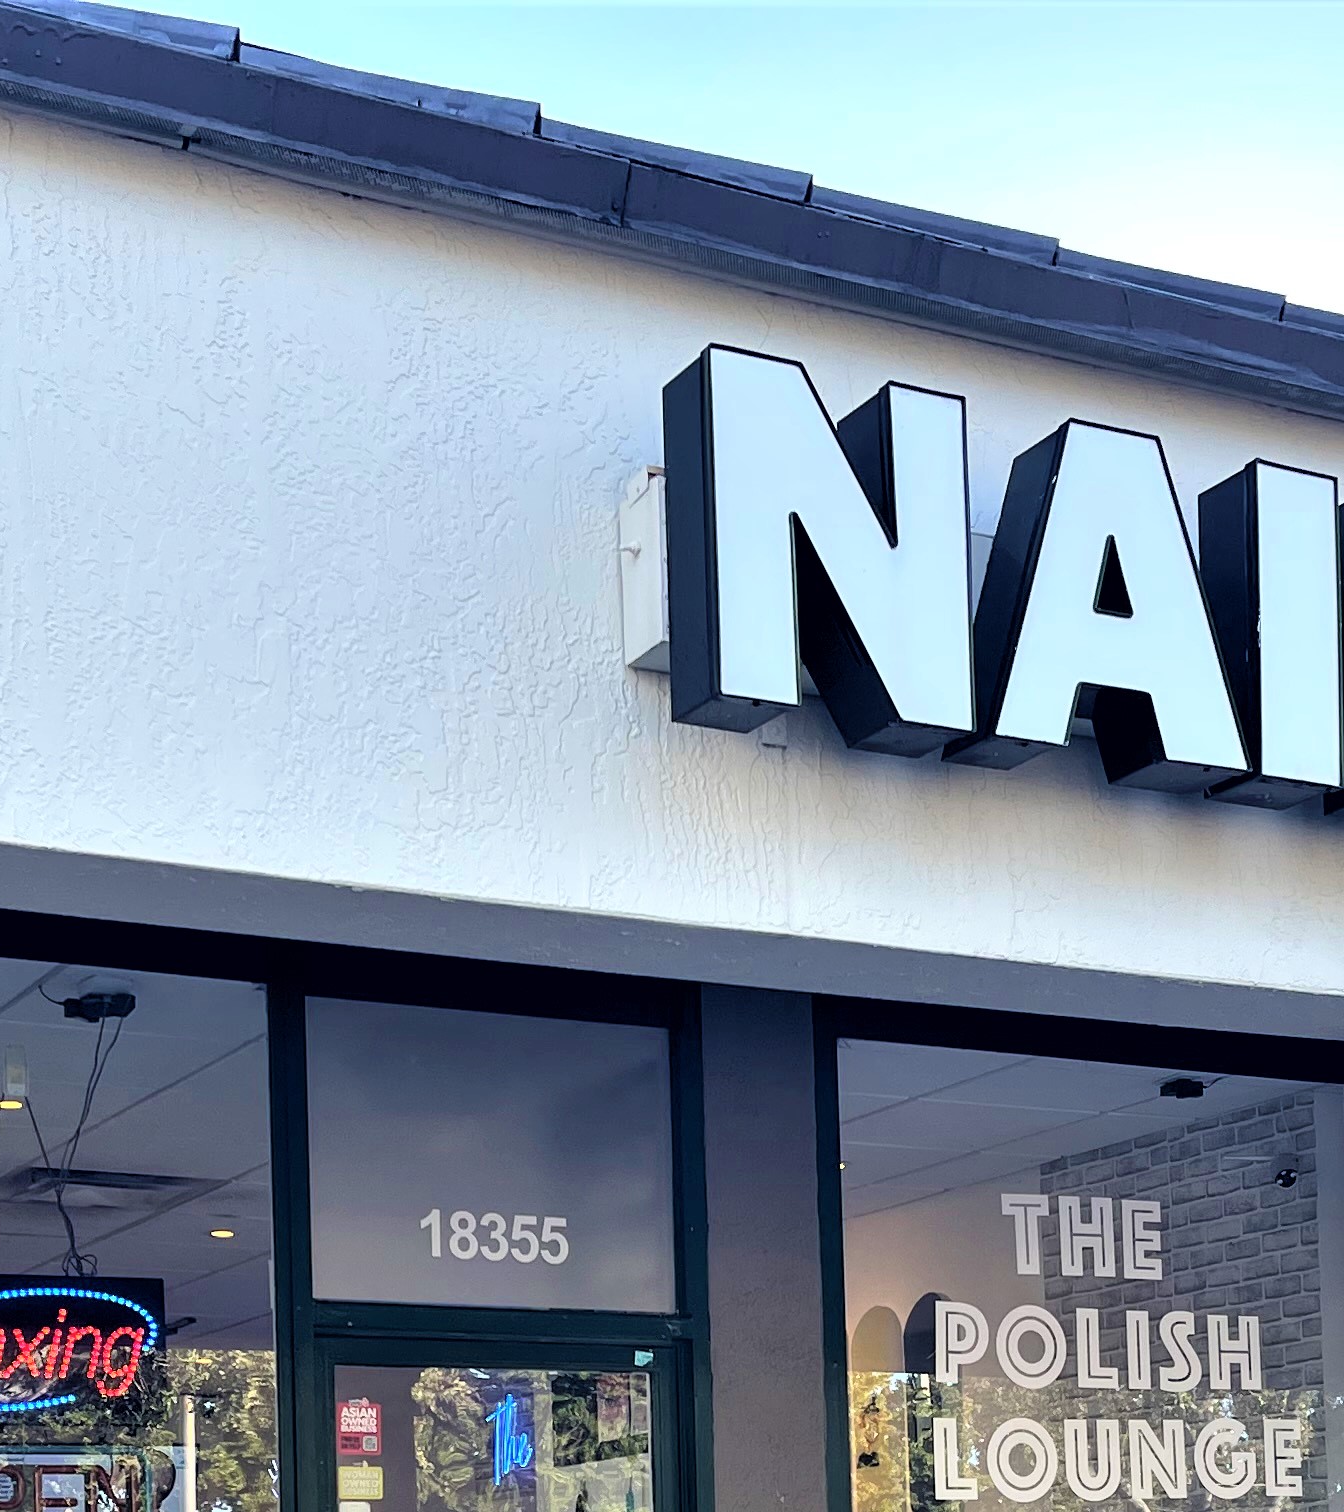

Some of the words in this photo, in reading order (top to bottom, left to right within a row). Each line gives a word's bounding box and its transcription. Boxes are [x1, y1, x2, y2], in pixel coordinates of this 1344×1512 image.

[419, 1208, 570, 1265] 18355
[1001, 1193, 1163, 1280] THE
[935, 1299, 1264, 1393] POLISH
[341, 1407, 377, 1420] ASIAN
[341, 1418, 377, 1427] OWNED
[934, 1418, 1304, 1503] LOUNGE
